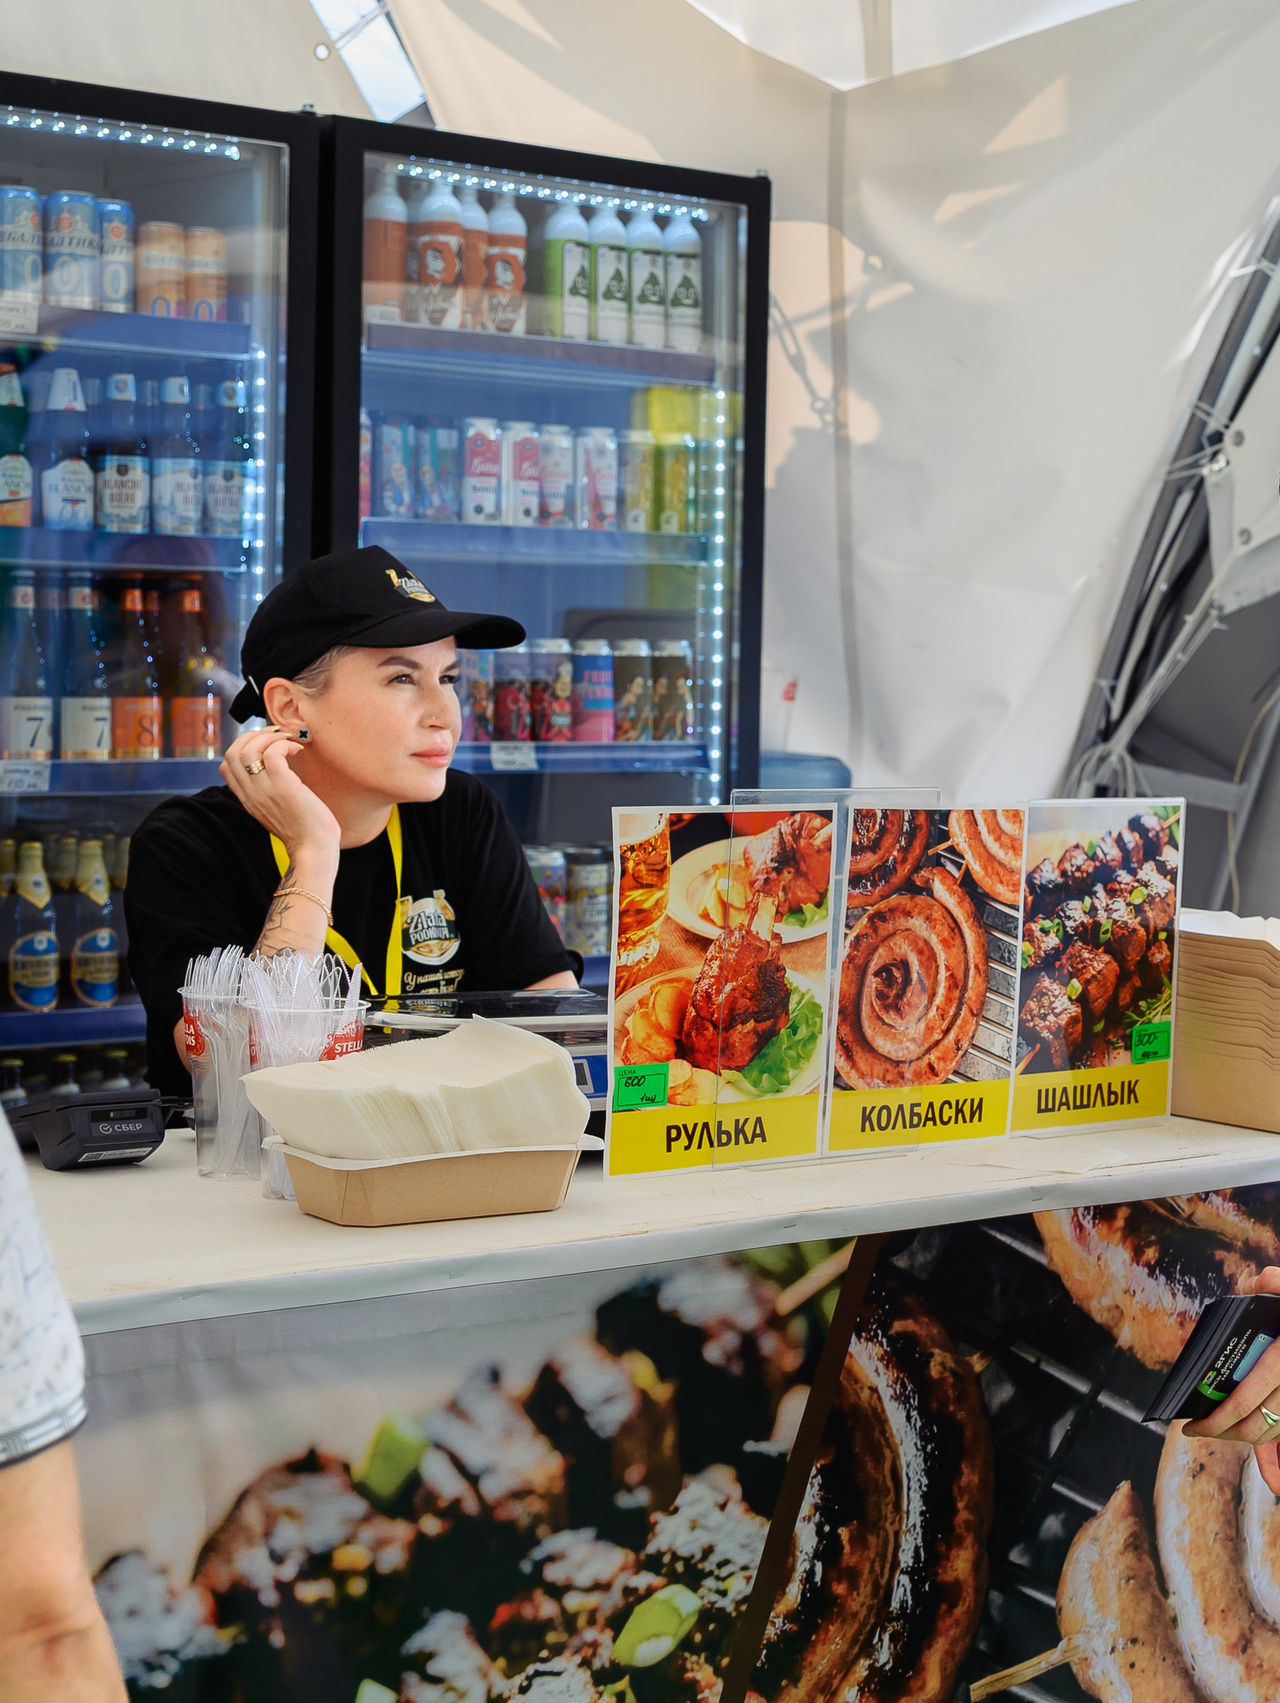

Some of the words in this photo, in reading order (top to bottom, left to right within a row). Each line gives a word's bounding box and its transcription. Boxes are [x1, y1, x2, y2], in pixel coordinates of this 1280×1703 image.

[26, 717, 44, 748] 7
[94, 717, 108, 747] 7
[618, 1069, 637, 1077] ЦЕНА
[624, 1075, 646, 1088] 600
[1036, 1079, 1140, 1114] ШАШЛЫК
[114, 1123, 143, 1132] СБЕР
[860, 1097, 984, 1133] КОЛБАСКИ
[665, 1116, 767, 1153] РУЛЬКА
[1214, 1337, 1238, 1369] 2ГИС
